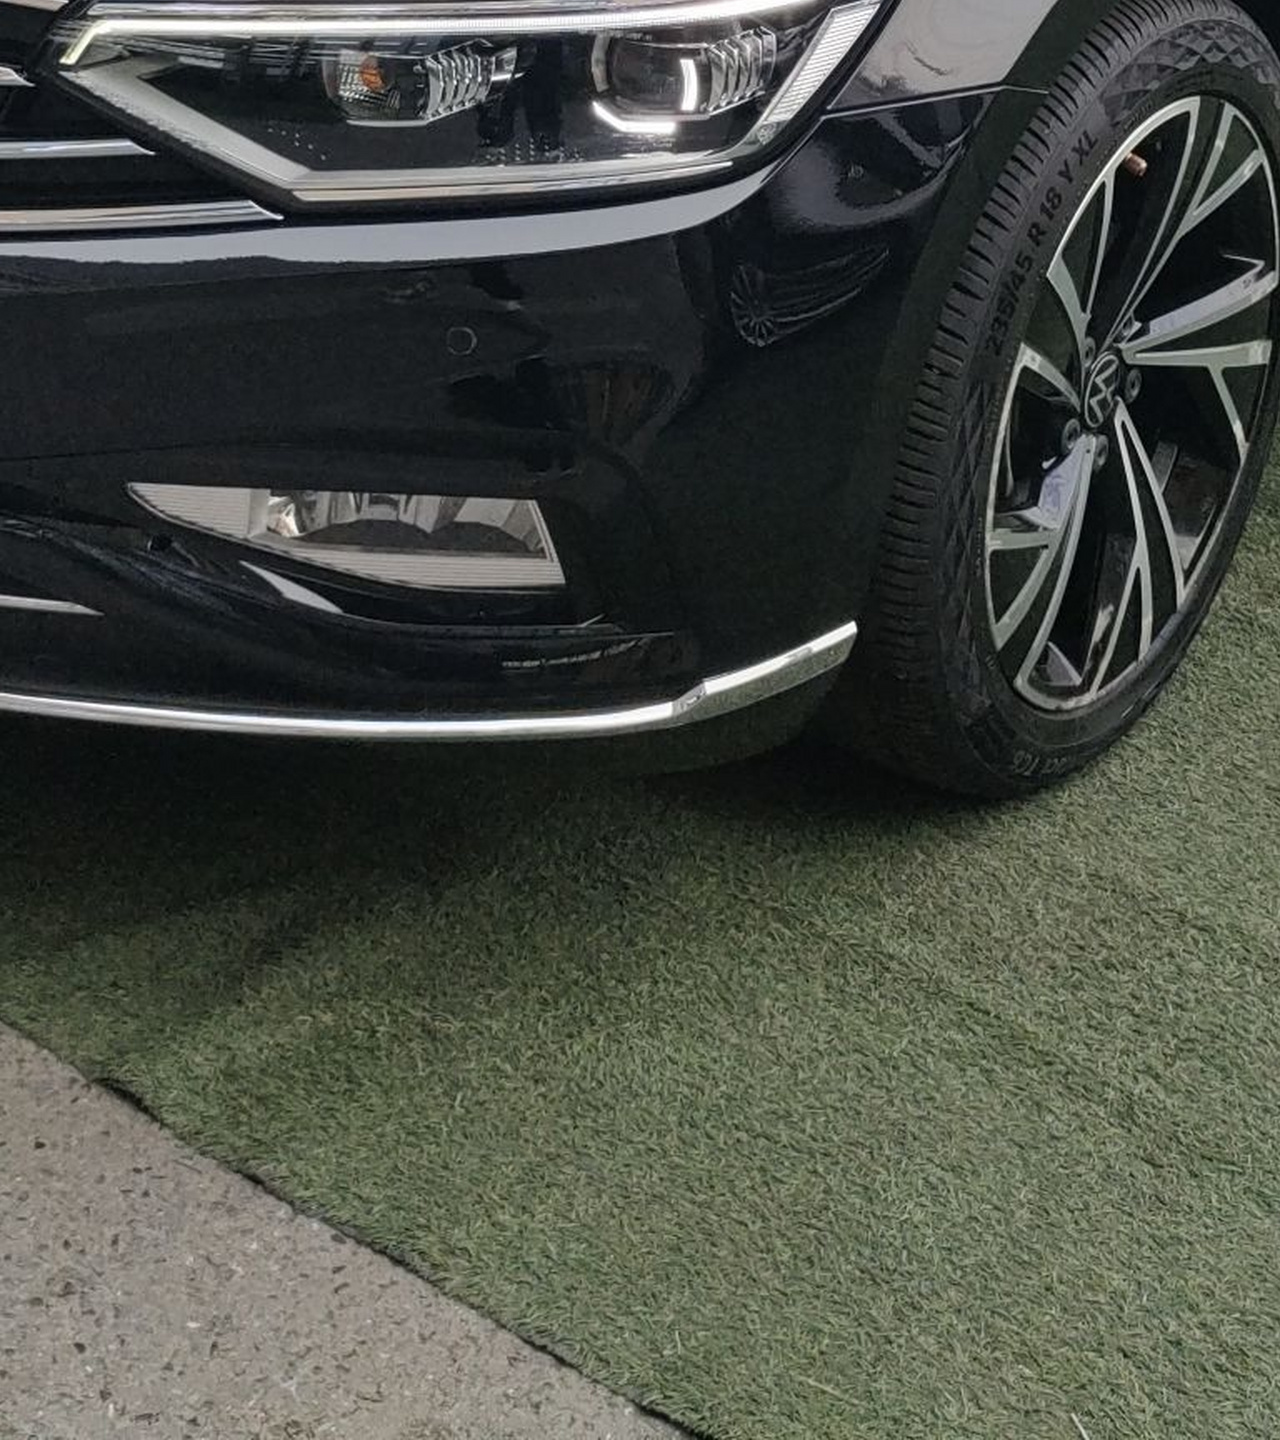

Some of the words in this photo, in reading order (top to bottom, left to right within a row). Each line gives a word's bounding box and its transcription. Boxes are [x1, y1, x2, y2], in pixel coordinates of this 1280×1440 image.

[1025, 223, 1048, 247] R
[1039, 186, 1064, 222] 18
[1071, 129, 1099, 162] XL
